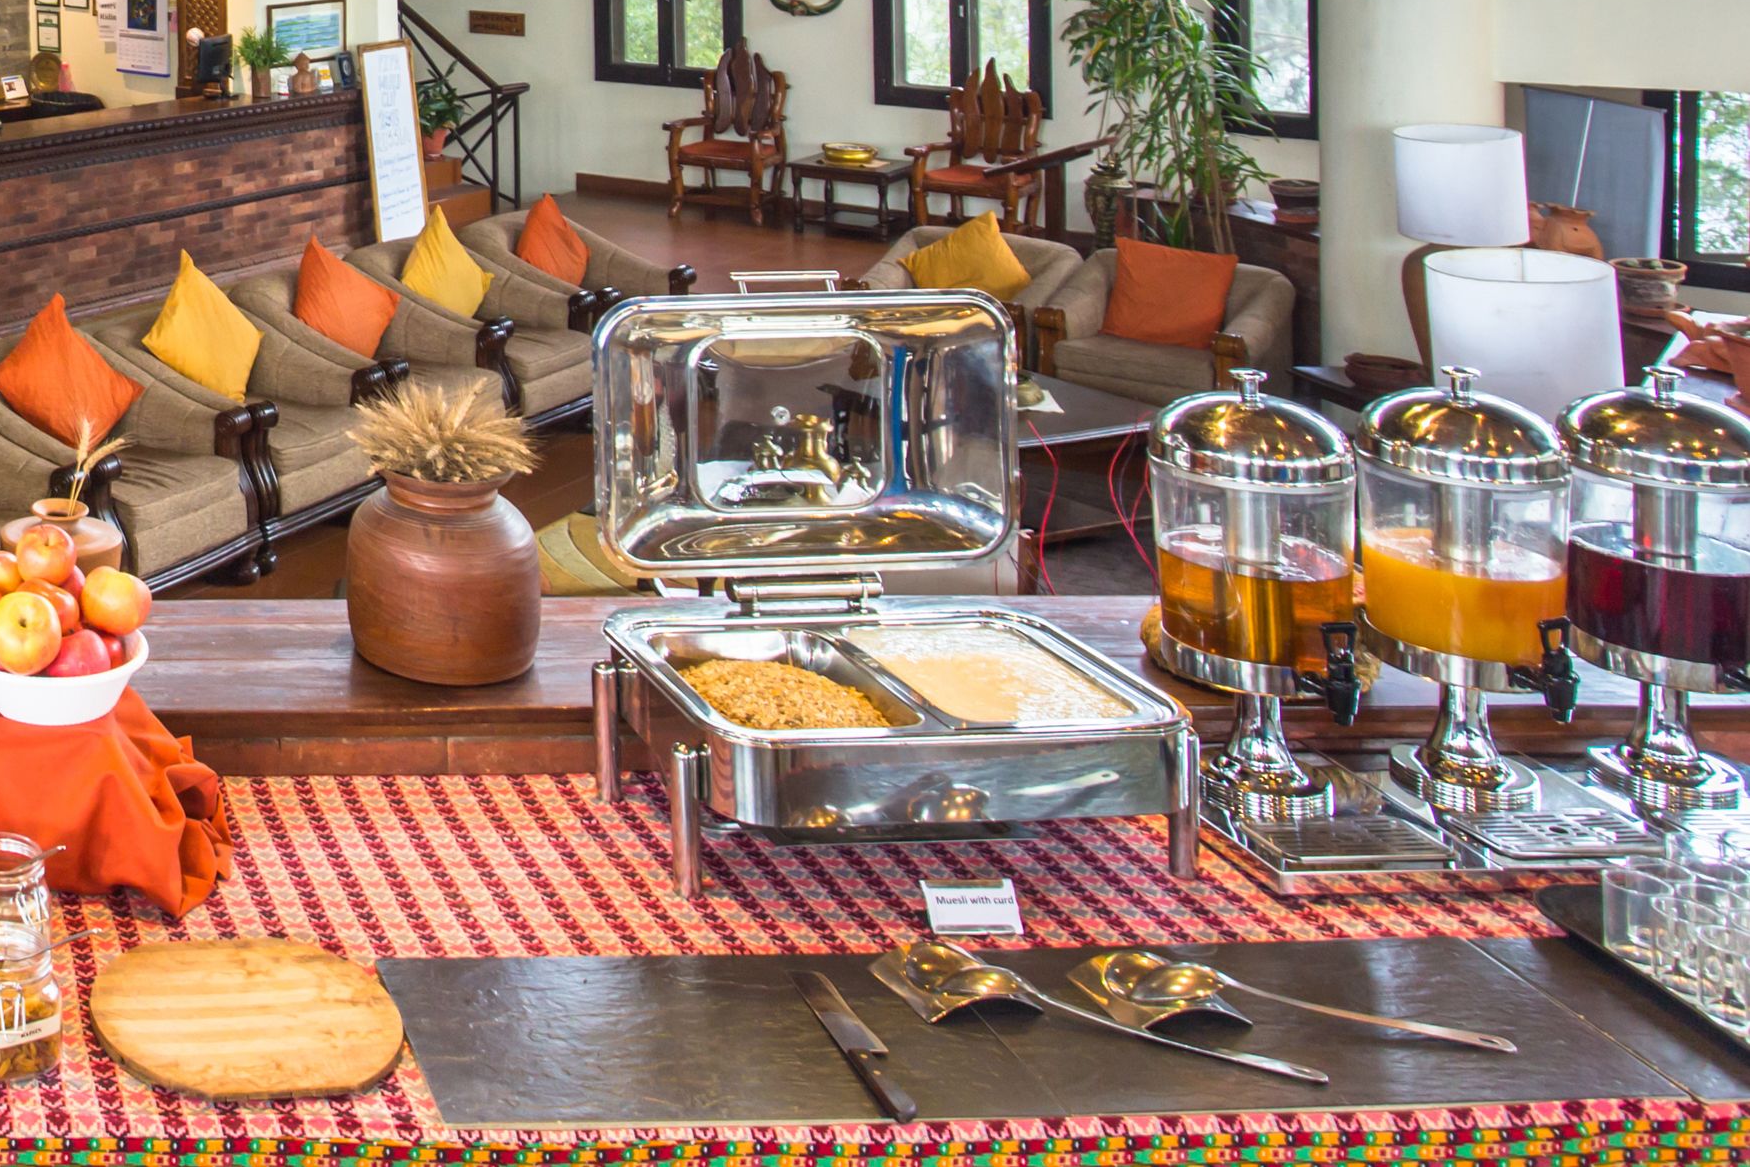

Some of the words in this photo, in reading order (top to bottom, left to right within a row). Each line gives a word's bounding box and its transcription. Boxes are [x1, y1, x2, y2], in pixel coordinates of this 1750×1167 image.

[936, 896, 968, 905] Muesli
[970, 896, 991, 905] with
[993, 896, 1014, 905] curd
